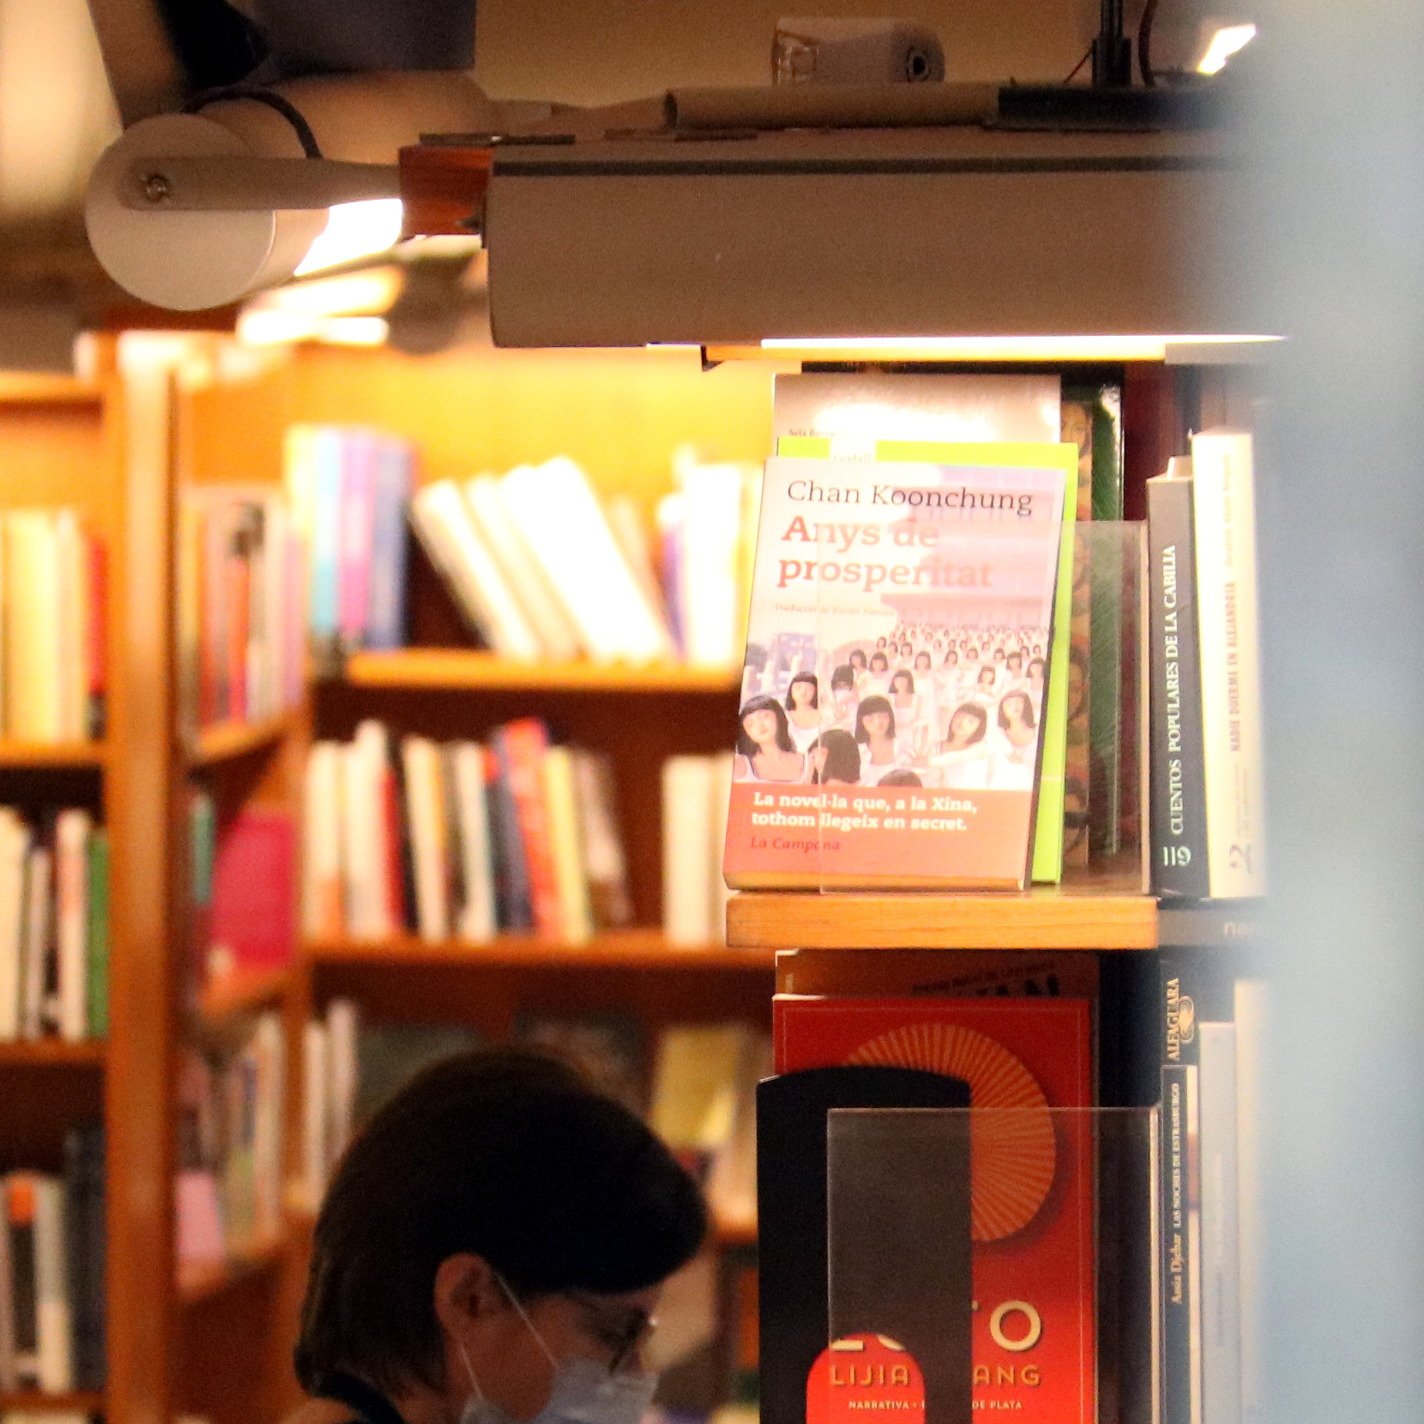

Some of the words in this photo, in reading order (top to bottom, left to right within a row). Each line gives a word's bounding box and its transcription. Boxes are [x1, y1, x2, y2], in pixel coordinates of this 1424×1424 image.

[787, 480, 860, 505] Chan
[872, 484, 1034, 516] Koonchung
[781, 515, 881, 553] Anys
[892, 519, 939, 548] de
[777, 558, 994, 592] prosperitat
[1161, 545, 1178, 609] CABILIA
[1163, 611, 1179, 632] LA
[1164, 633, 1180, 658] DE
[1226, 652, 1238, 666] EN
[1164, 661, 1183, 754] POPULARES
[1226, 670, 1240, 715] DUERME
[1228, 720, 1241, 752] NADIE
[753, 791, 774, 808] La
[852, 797, 891, 814] que,
[895, 799, 906, 811] a
[910, 797, 926, 811] la
[931, 797, 978, 814] Xina,
[1168, 759, 1186, 836] CUENTOS
[751, 811, 816, 828] tothom
[819, 812, 879, 832] llegeix
[884, 816, 906, 829] en
[910, 816, 968, 831] secret.
[750, 836, 767, 849] La
[772, 836, 841, 853] Campana
[1167, 977, 1180, 1061] ALFAGUARA
[1169, 1233, 1186, 1274] Djebar
[830, 1364, 910, 1387] LIJIA
[973, 1364, 1041, 1387] ANG
[848, 1400, 910, 1410] NARRATIVA
[989, 1400, 1022, 1410] PLATA
